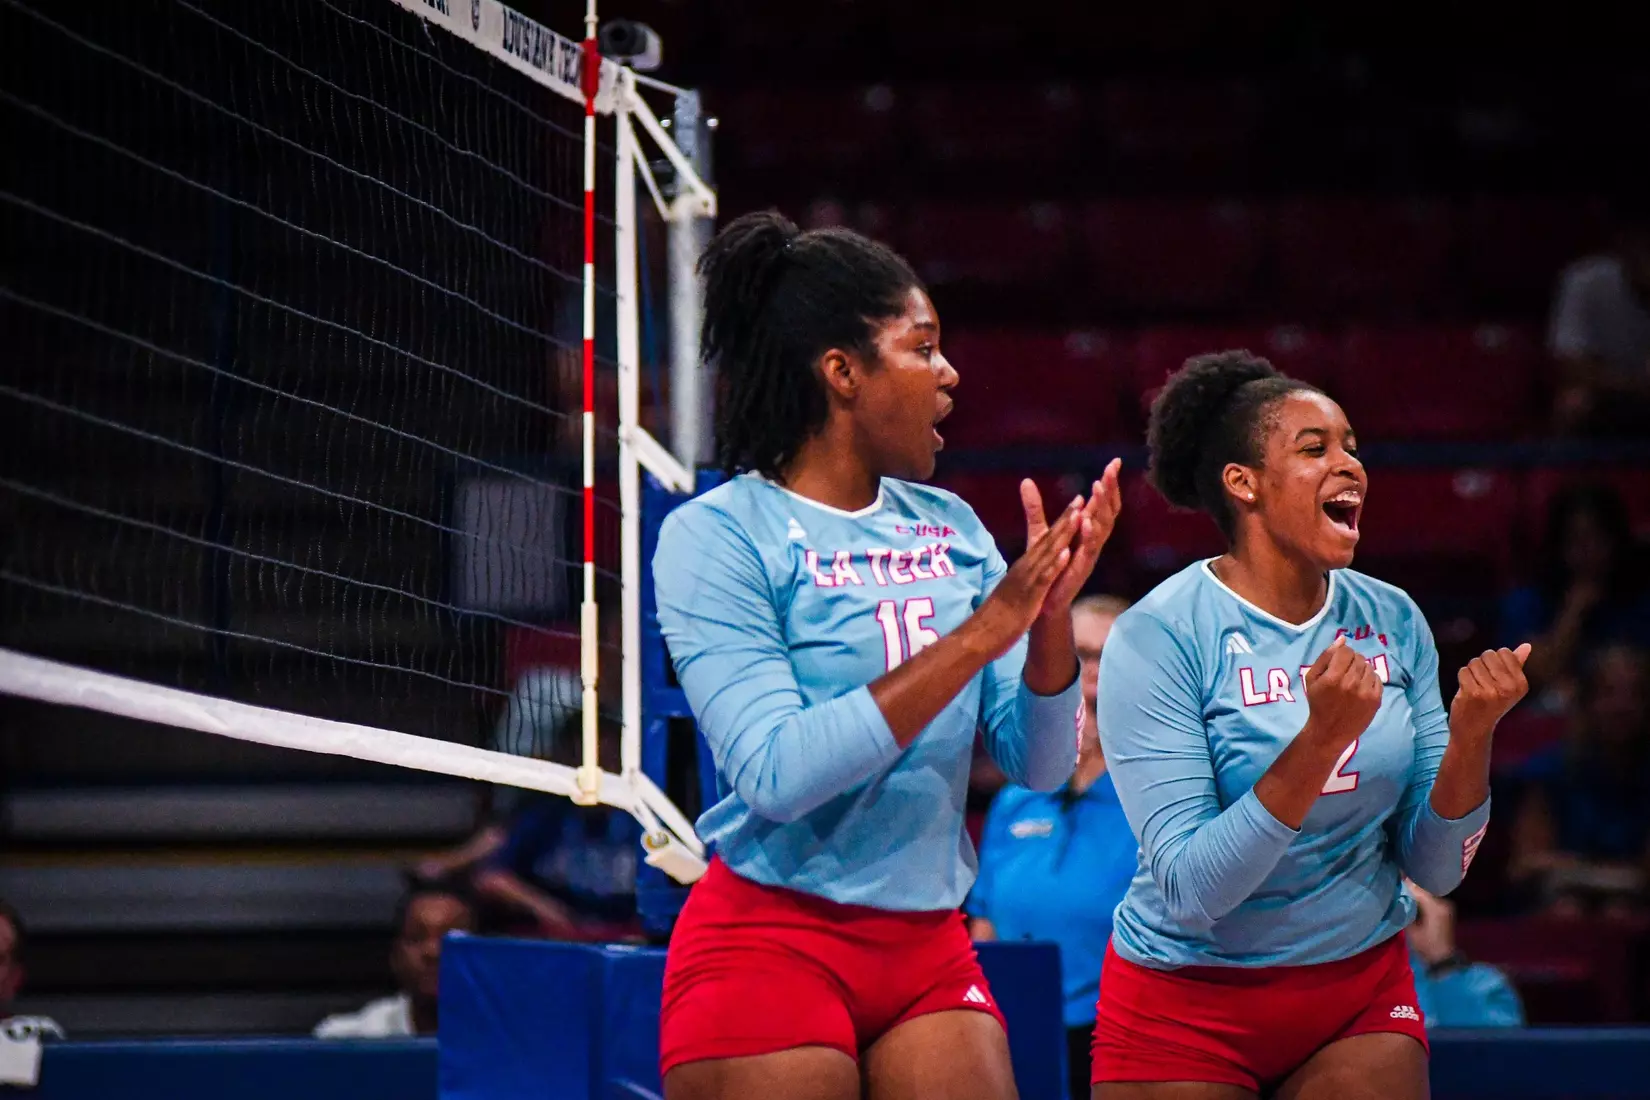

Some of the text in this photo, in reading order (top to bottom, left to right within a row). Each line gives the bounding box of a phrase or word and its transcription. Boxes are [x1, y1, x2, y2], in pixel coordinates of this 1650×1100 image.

[806, 544, 956, 587] LA TECH
[1239, 668, 1296, 707] LA
[1321, 739, 1360, 796] 2
